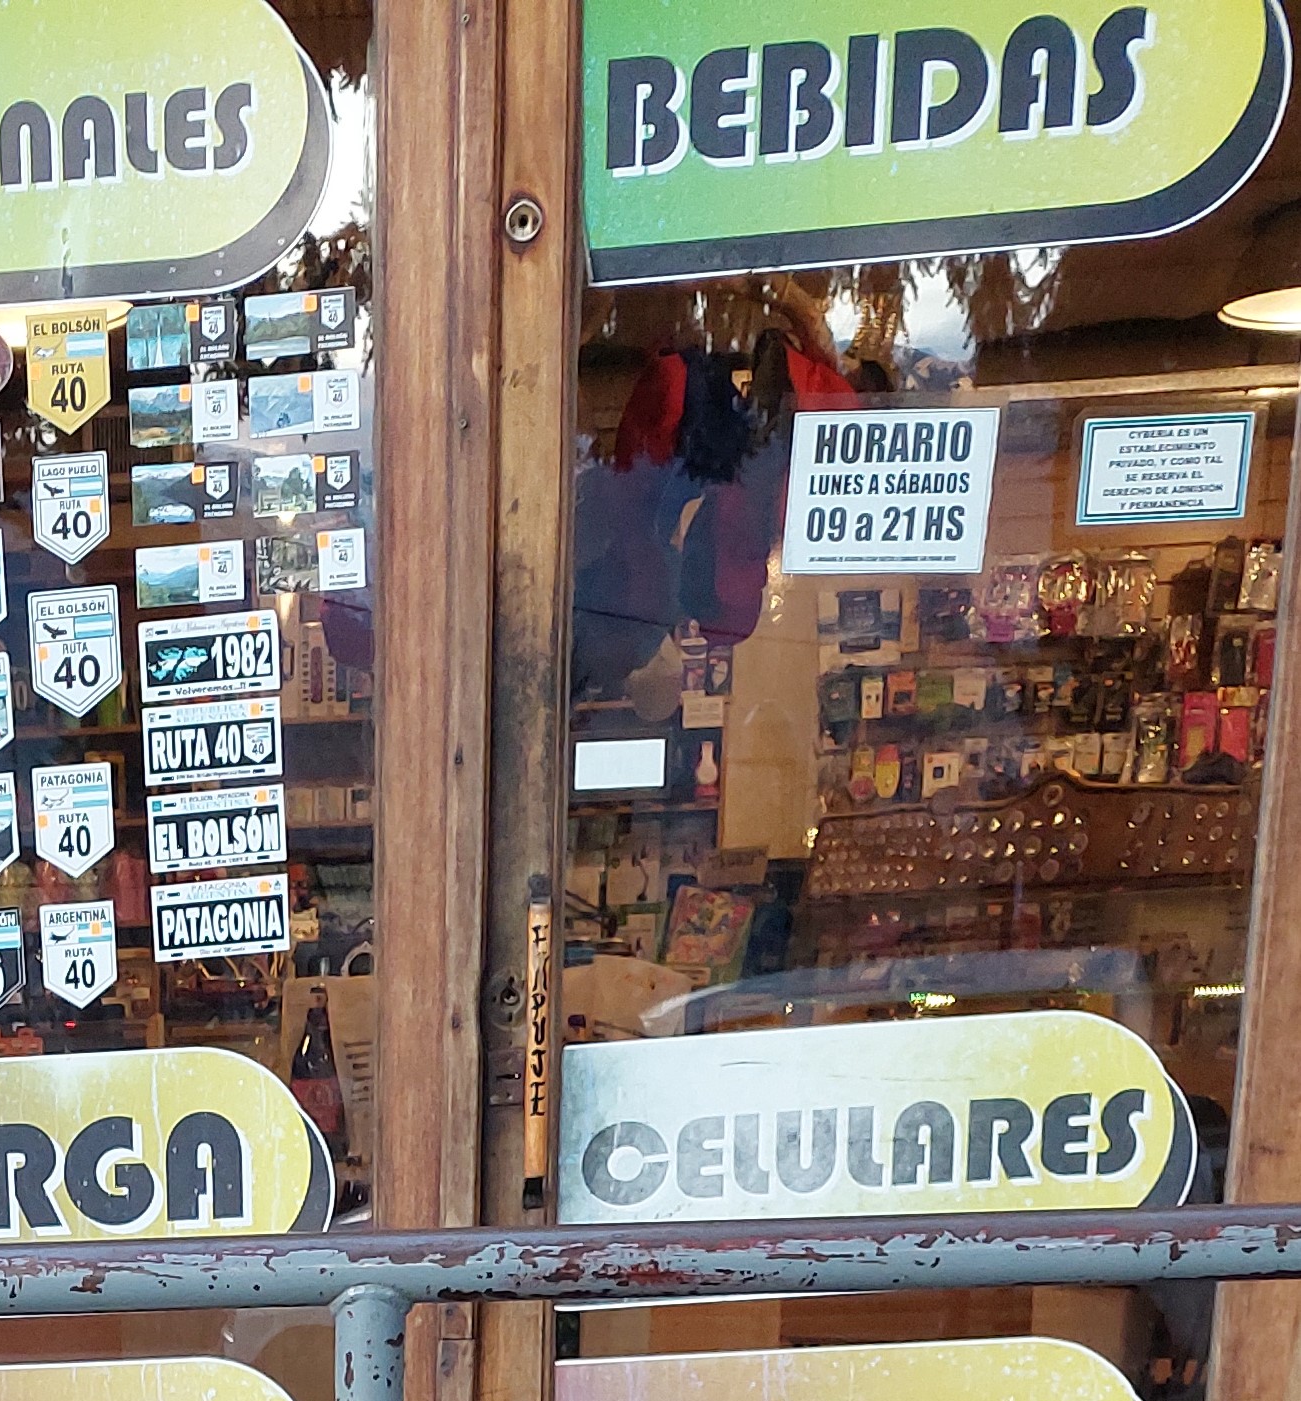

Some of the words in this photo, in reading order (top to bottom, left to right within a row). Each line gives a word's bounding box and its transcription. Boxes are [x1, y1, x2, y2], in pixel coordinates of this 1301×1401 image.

[606, 7, 1155, 178] BEBIDAS
[33, 323, 48, 336] EL
[51, 316, 100, 335] BOLSÓN
[51, 362, 85, 375] RUTA
[51, 376, 87, 413] 40
[814, 420, 973, 464] HORARIO
[1119, 441, 1216, 454] ESTABLECIMIENTO
[69, 465, 97, 475] PUELO
[1108, 458, 1157, 469] PRIVADO,
[1160, 458, 1168, 466] Y
[1170, 457, 1201, 466] COMO
[1204, 455, 1223, 465] TAL
[809, 474, 864, 496] LUNES
[867, 474, 879, 495] A
[884, 468, 970, 495] SÁBADOS
[1125, 473, 1138, 483] SE
[1141, 470, 1189, 481] RESERVA
[1191, 470, 1204, 479] EL
[1102, 487, 1153, 497] DERECHO
[1155, 486, 1169, 495] DE
[59, 500, 81, 511] RUTA
[1119, 502, 1126, 510] Y
[1128, 499, 1204, 510] PERMANENCIA
[52, 511, 92, 540] 40
[806, 506, 847, 542] 09
[855, 512, 874, 542] a
[881, 505, 917, 541] 21
[923, 505, 965, 541] HS
[40, 606, 54, 616] EL
[58, 600, 106, 615] BOLSÓN
[62, 642, 89, 655] RUTA
[210, 632, 271, 679] 1982
[54, 655, 101, 689] 40
[151, 727, 211, 771] RUTA
[213, 724, 242, 765] 40
[251, 742, 265, 755] 40
[40, 771, 103, 787] PATAGONIA
[59, 812, 89, 824] RUTA
[58, 825, 91, 858] 40
[155, 823, 184, 862] EL
[186, 808, 279, 858] BOLSÓN
[191, 881, 248, 892] PATAGONIA
[49, 908, 107, 925] ARGENTINA
[161, 899, 282, 947] PATAGONIA
[64, 947, 94, 958] RUTA
[65, 958, 96, 990] 40
[580, 1088, 1153, 1207] CELULARES
